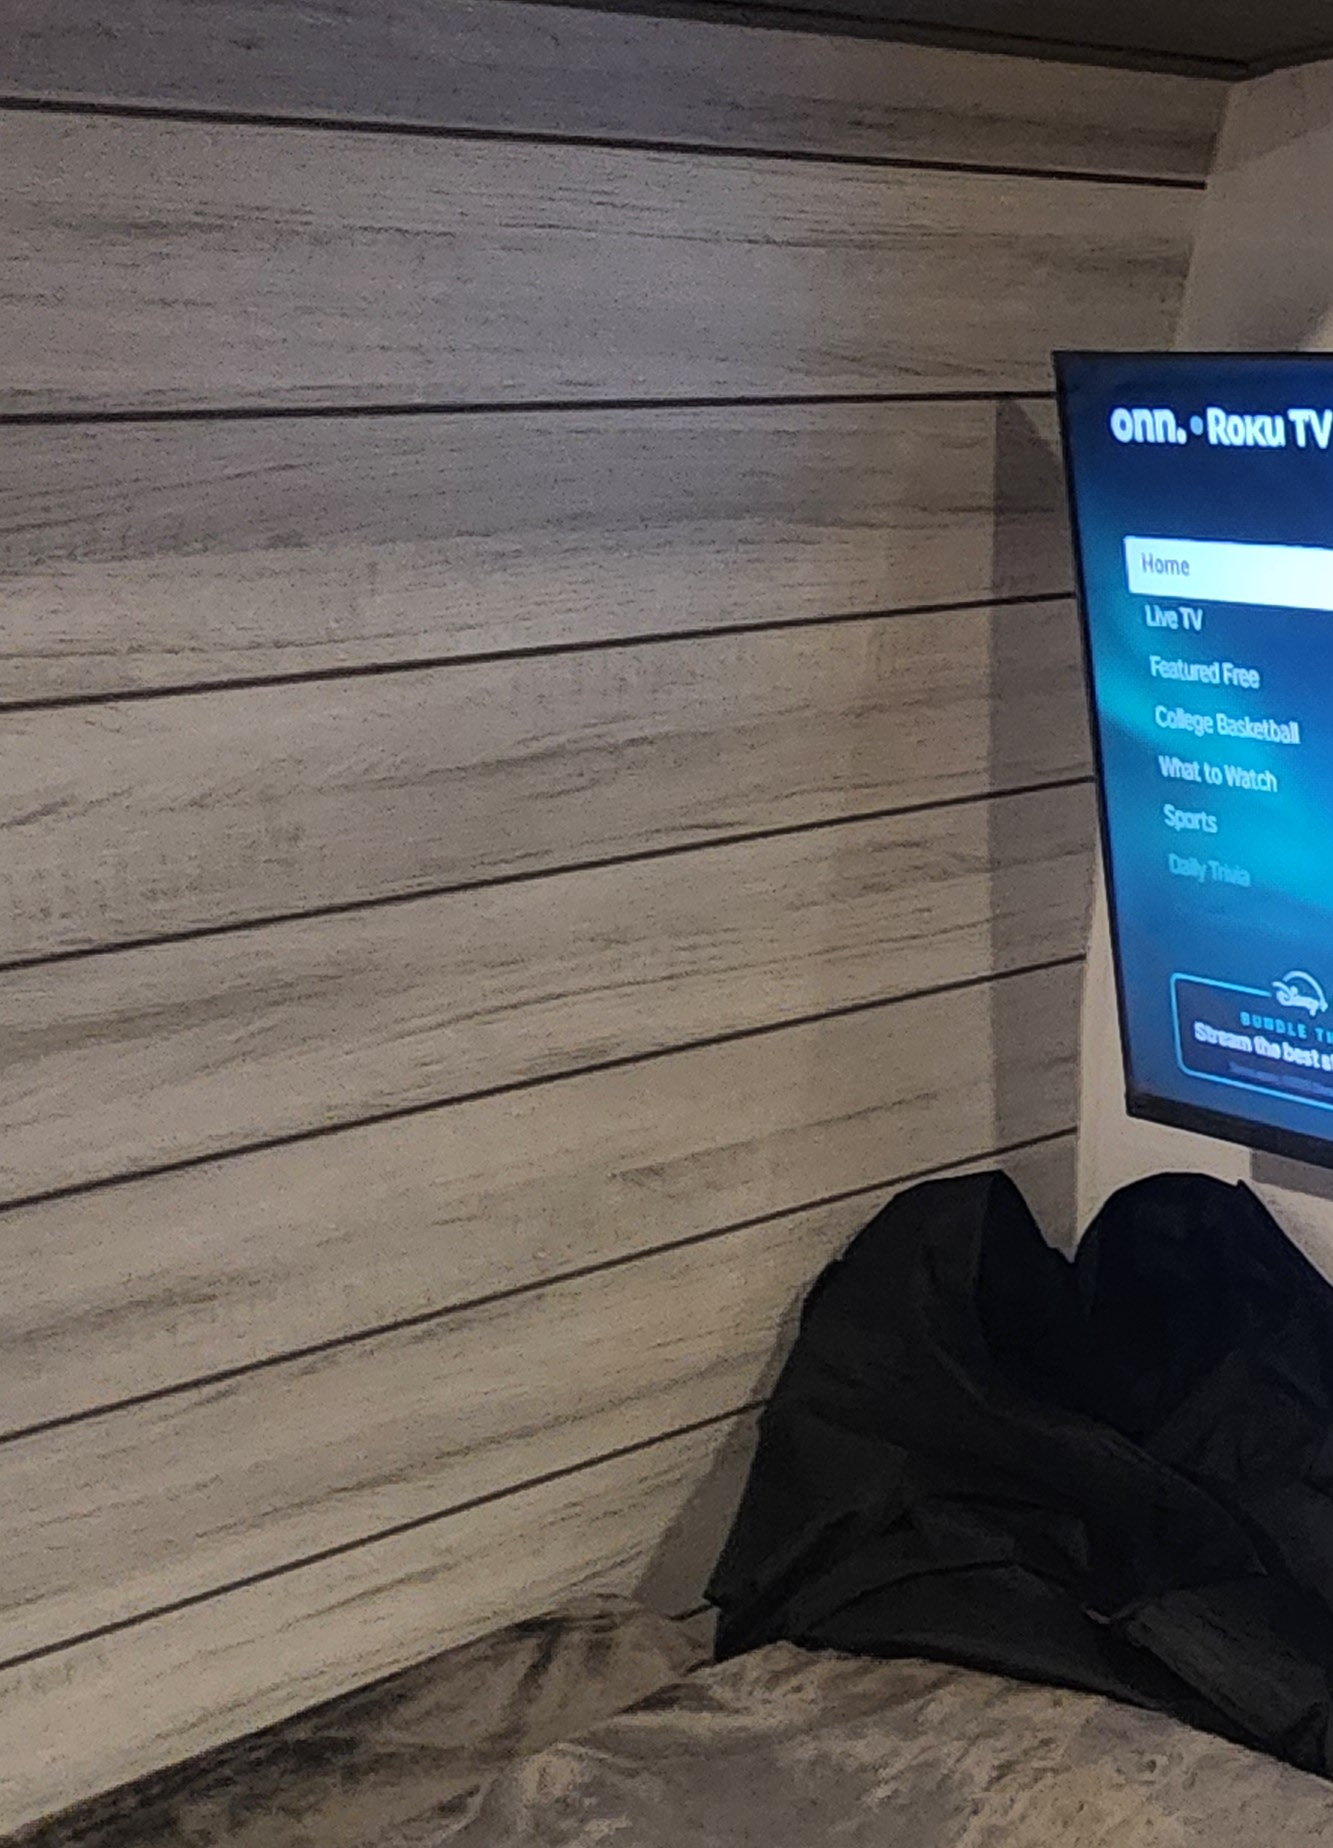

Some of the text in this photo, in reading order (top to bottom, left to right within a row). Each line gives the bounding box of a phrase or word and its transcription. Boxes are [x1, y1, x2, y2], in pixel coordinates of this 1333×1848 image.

[1110, 407, 1333, 449] onn. Roku TV
[1141, 552, 1190, 576] Home
[1144, 604, 1204, 631] Live TV
[1149, 655, 1261, 689] Featured Free
[1154, 705, 1300, 745] College Basketball
[1158, 755, 1278, 793] What to Watch
[1163, 803, 1218, 834] Sports
[1168, 853, 1251, 888] Daily Trivia
[1240, 1011, 1306, 1040] BUNDLE
[1194, 1020, 1252, 1053] Stream
[1252, 1032, 1282, 1061] the
[1282, 1041, 1320, 1070] best
